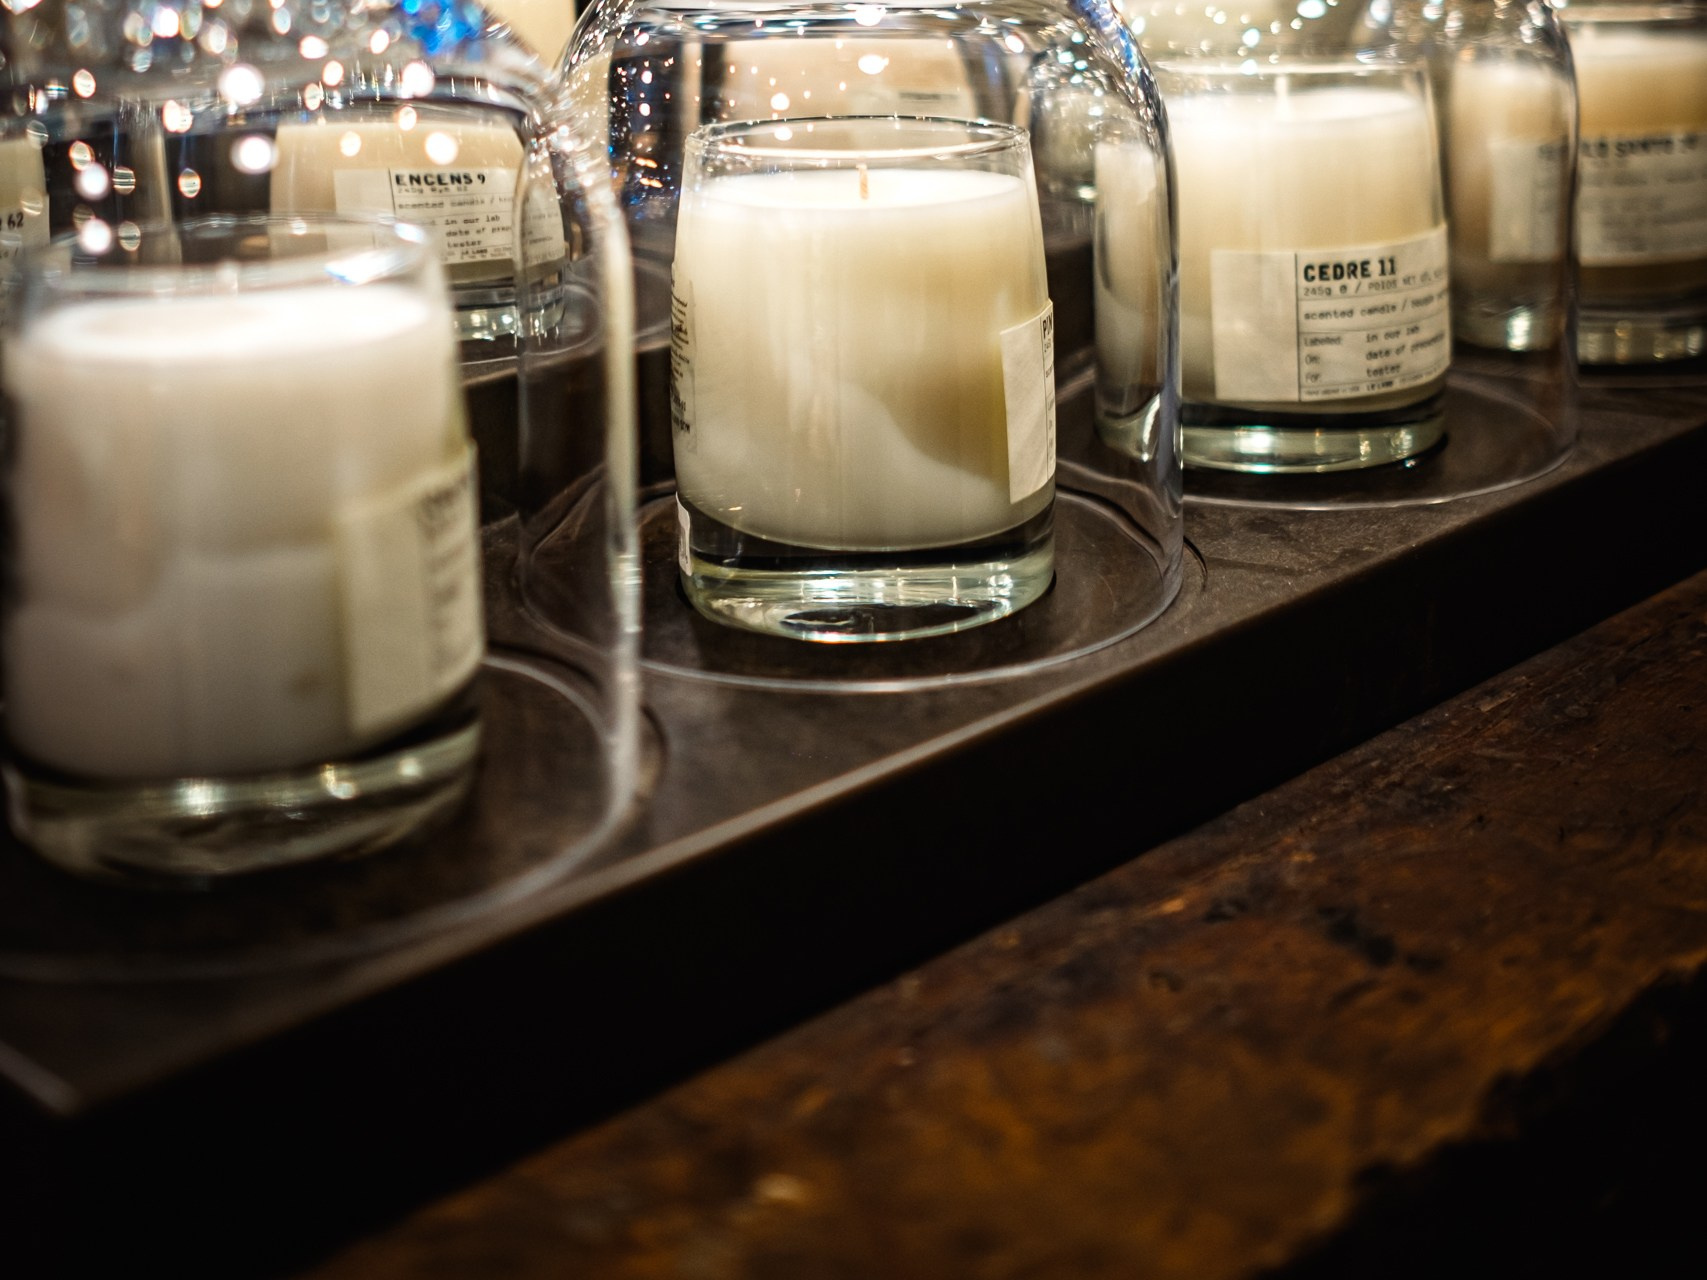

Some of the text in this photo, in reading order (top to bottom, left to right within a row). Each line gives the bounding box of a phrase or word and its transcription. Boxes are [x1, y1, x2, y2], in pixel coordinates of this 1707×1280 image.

[394, 172, 486, 186] ENCENS 9
[8, 211, 24, 229] 62
[486, 214, 500, 223] lab
[1303, 260, 1371, 282] CEDRE
[1378, 255, 1397, 276] 11
[1304, 308, 1354, 320] scented
